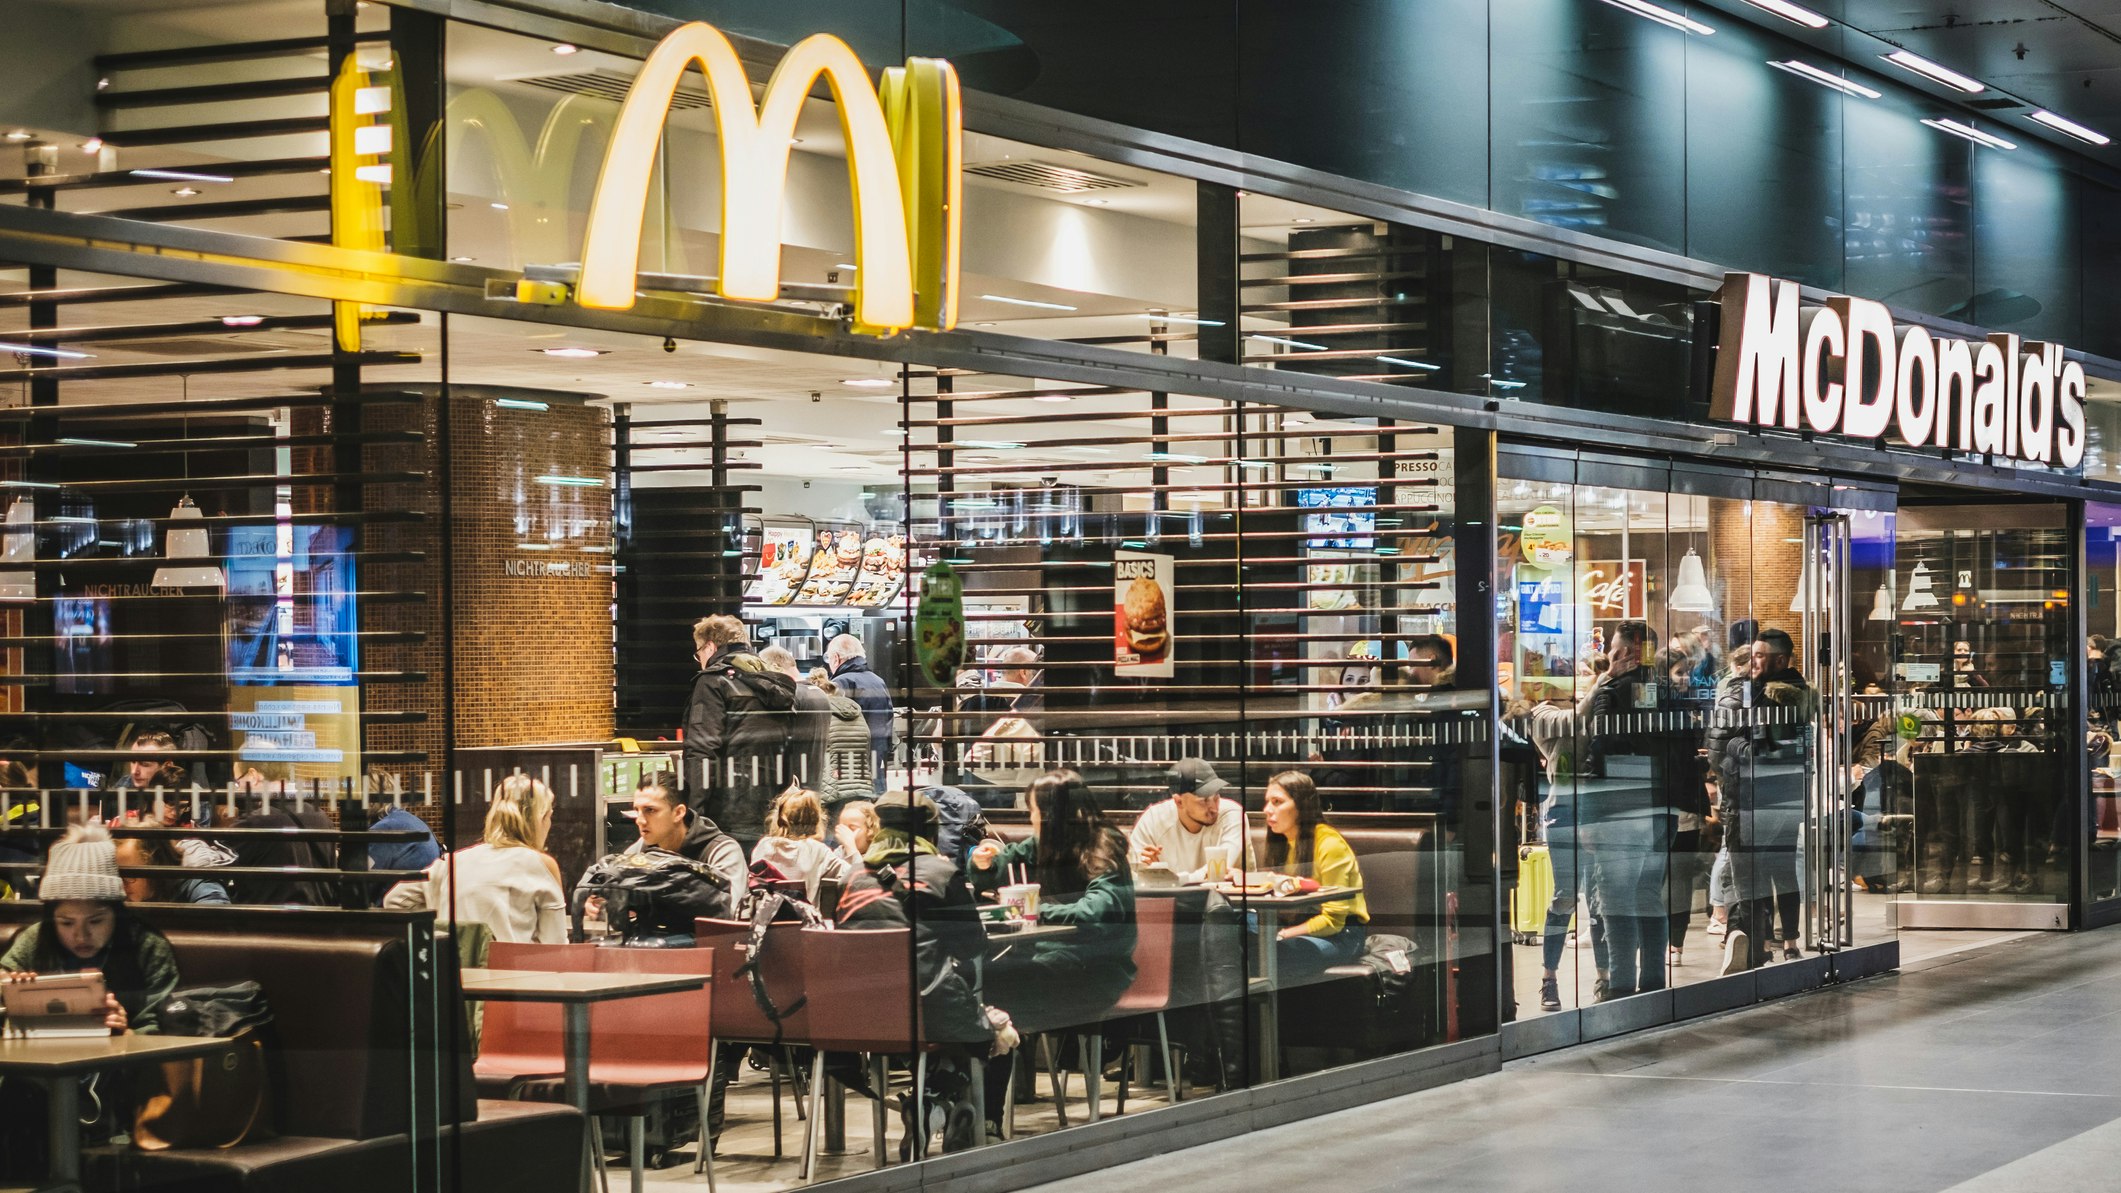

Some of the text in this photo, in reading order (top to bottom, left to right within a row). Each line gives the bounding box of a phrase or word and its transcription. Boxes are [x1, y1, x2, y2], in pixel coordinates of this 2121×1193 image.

[1731, 272, 2087, 469] McDonald's
[505, 560, 590, 576] NICHTRAUCHER
[1117, 561, 1154, 579] BASICS
[84, 584, 184, 596] NICHTRAUCHER
